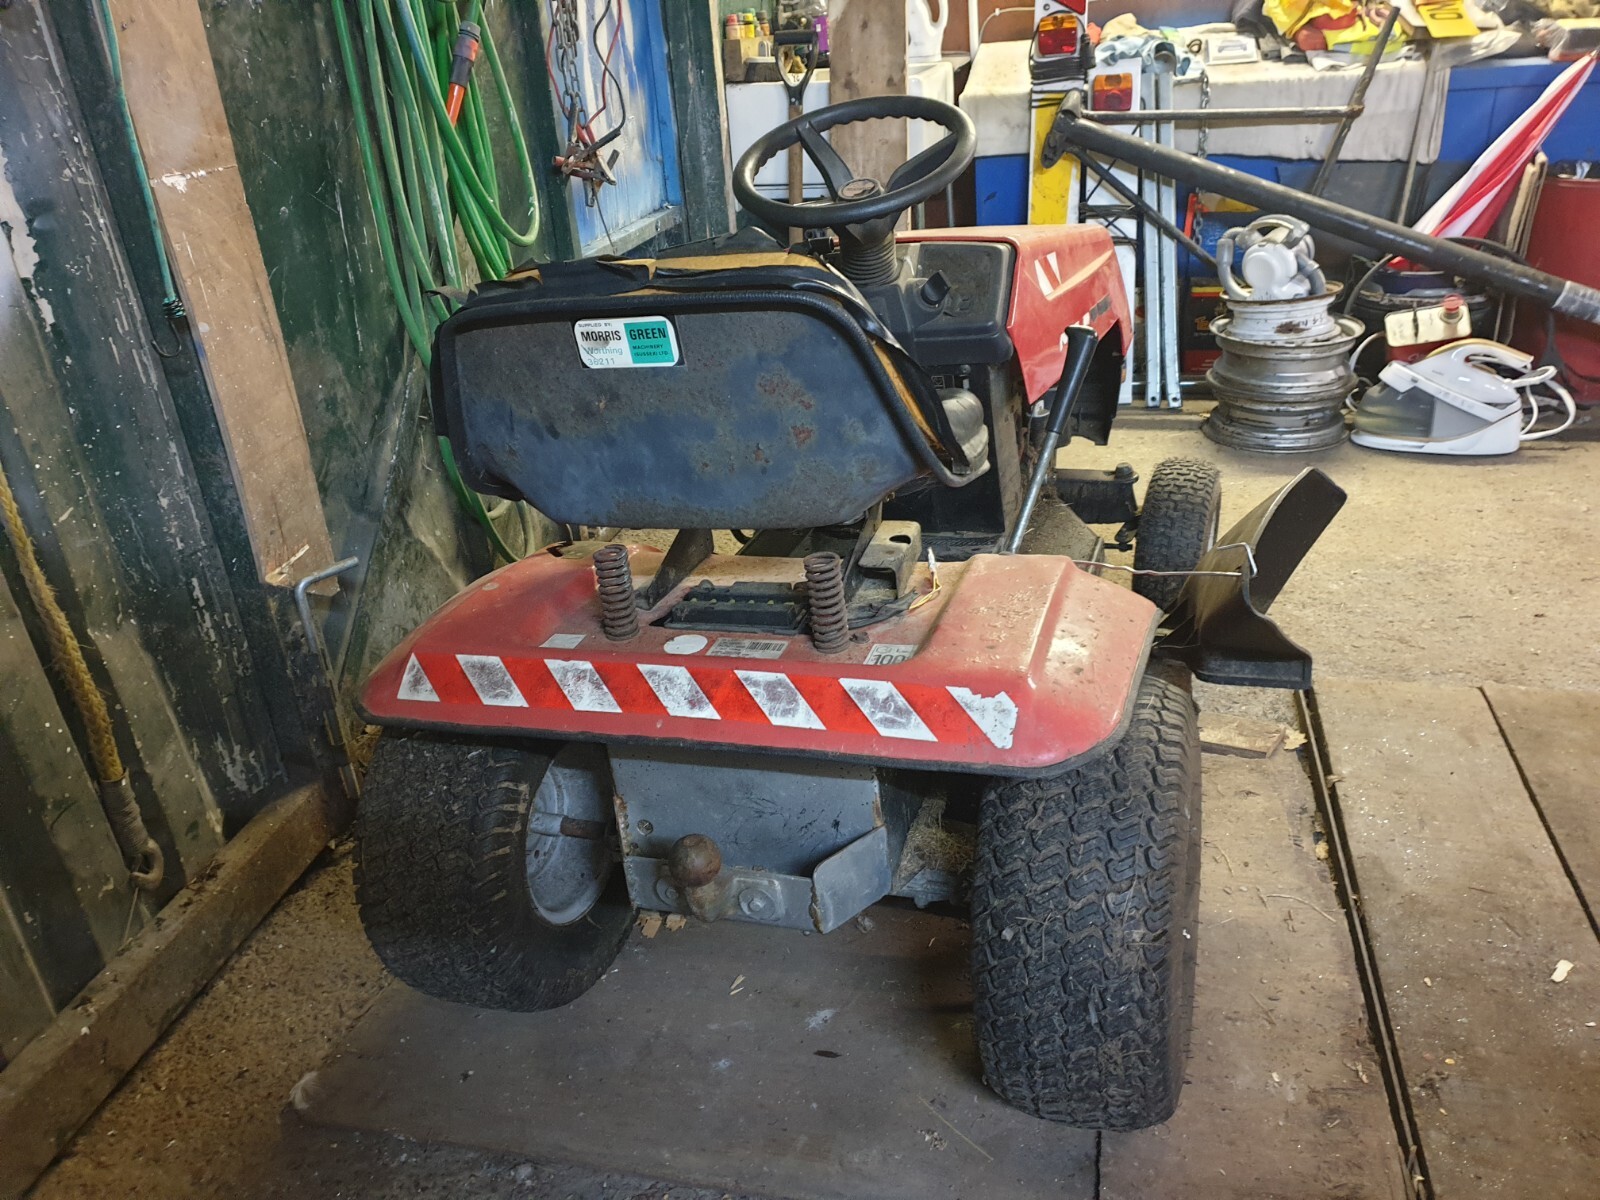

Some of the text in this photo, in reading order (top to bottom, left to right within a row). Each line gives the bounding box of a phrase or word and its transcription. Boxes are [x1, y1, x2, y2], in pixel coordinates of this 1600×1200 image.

[580, 327, 667, 342] MORRIS GREEN
[587, 346, 623, 356] Worthing
